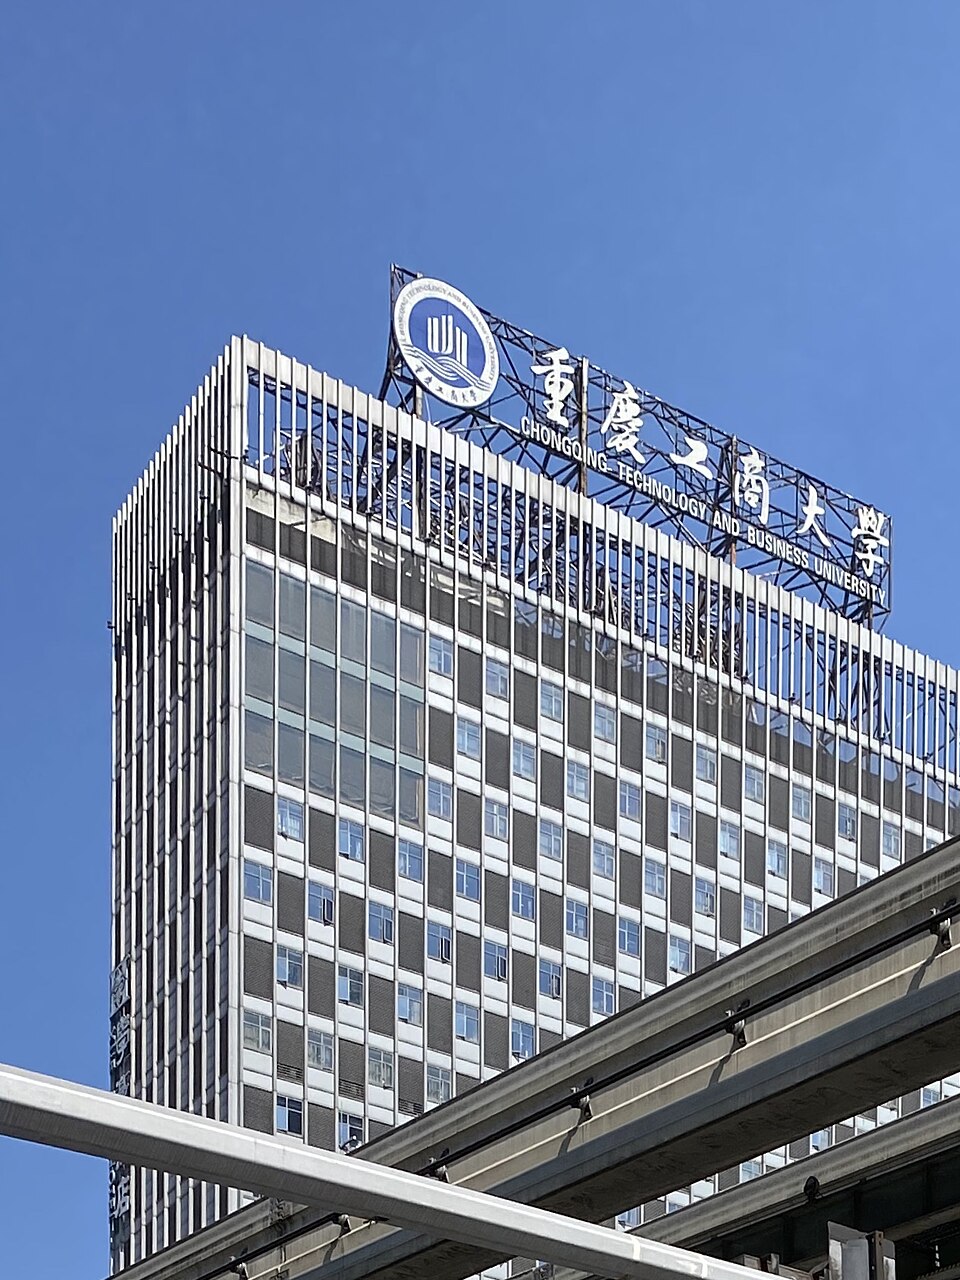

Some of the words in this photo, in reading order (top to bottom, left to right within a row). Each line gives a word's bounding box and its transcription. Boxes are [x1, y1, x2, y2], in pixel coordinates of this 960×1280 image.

[520, 416, 608, 472] CHONGQING
[617, 461, 707, 520] TECHNOLOGY
[713, 511, 740, 536] AND
[747, 527, 809, 570] BUSINESS
[814, 556, 886, 606] UNIVERSITY
